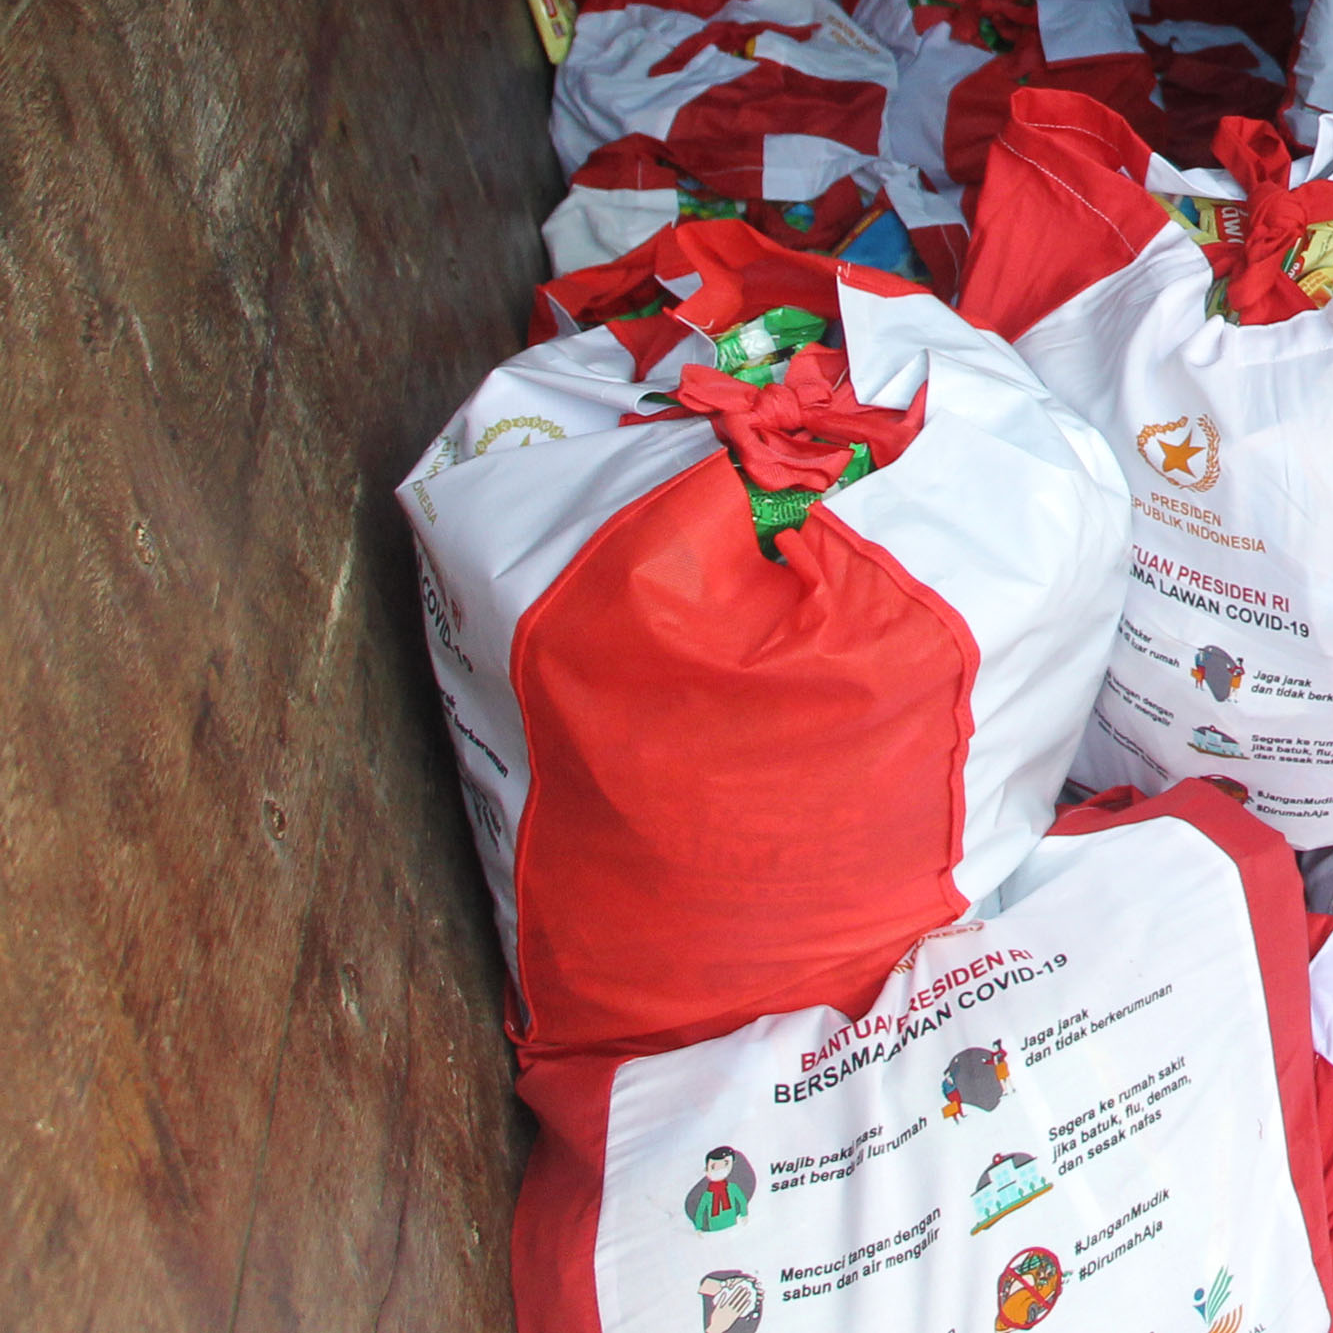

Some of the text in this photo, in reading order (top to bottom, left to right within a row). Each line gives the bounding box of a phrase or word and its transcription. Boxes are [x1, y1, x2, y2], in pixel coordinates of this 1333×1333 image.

[1150, 491, 1222, 527] PRESIDEN
[1186, 523, 1267, 554] INDONESIA
[1159, 579, 1220, 616] LAWAN
[1225, 603, 1310, 639] COVID-19
[1177, 565, 1266, 607] PRESIDEN
[1272, 595, 1290, 613] RI
[1149, 649, 1181, 669] rumah
[1253, 670, 1312, 688] Jaga jarak
[1251, 684, 1274, 695] dan
[1276, 687, 1306, 700] tidak
[1251, 735, 1294, 746] Segera
[1295, 737, 1311, 746] ke
[1251, 743, 1274, 753] jika
[1276, 745, 1313, 757] batuk,
[1253, 753, 1276, 762] dan
[1278, 756, 1313, 765] sesak
[773, 952, 1069, 1105] BERSAMA AWAN COVID-19
[1020, 1008, 1090, 1053] Jaga jarak
[1025, 983, 1174, 1068] dan tidak berkerumunan
[1048, 1055, 1187, 1143] Segera ke rumah sakit
[1052, 1074, 1193, 1164] jika batuk, flu, demam,
[770, 1173, 806, 1193] saat
[886, 1116, 928, 1153] rumah
[770, 1157, 816, 1176] Wajib
[1058, 1108, 1163, 1177] dan sesak nafas
[780, 1207, 941, 1284] Mencuci tangan dengan
[1074, 1187, 1172, 1256] #JanganMudik
[782, 1227, 942, 1303] sabun dan air mengalir
[1078, 1219, 1164, 1283] #DirumahAja
